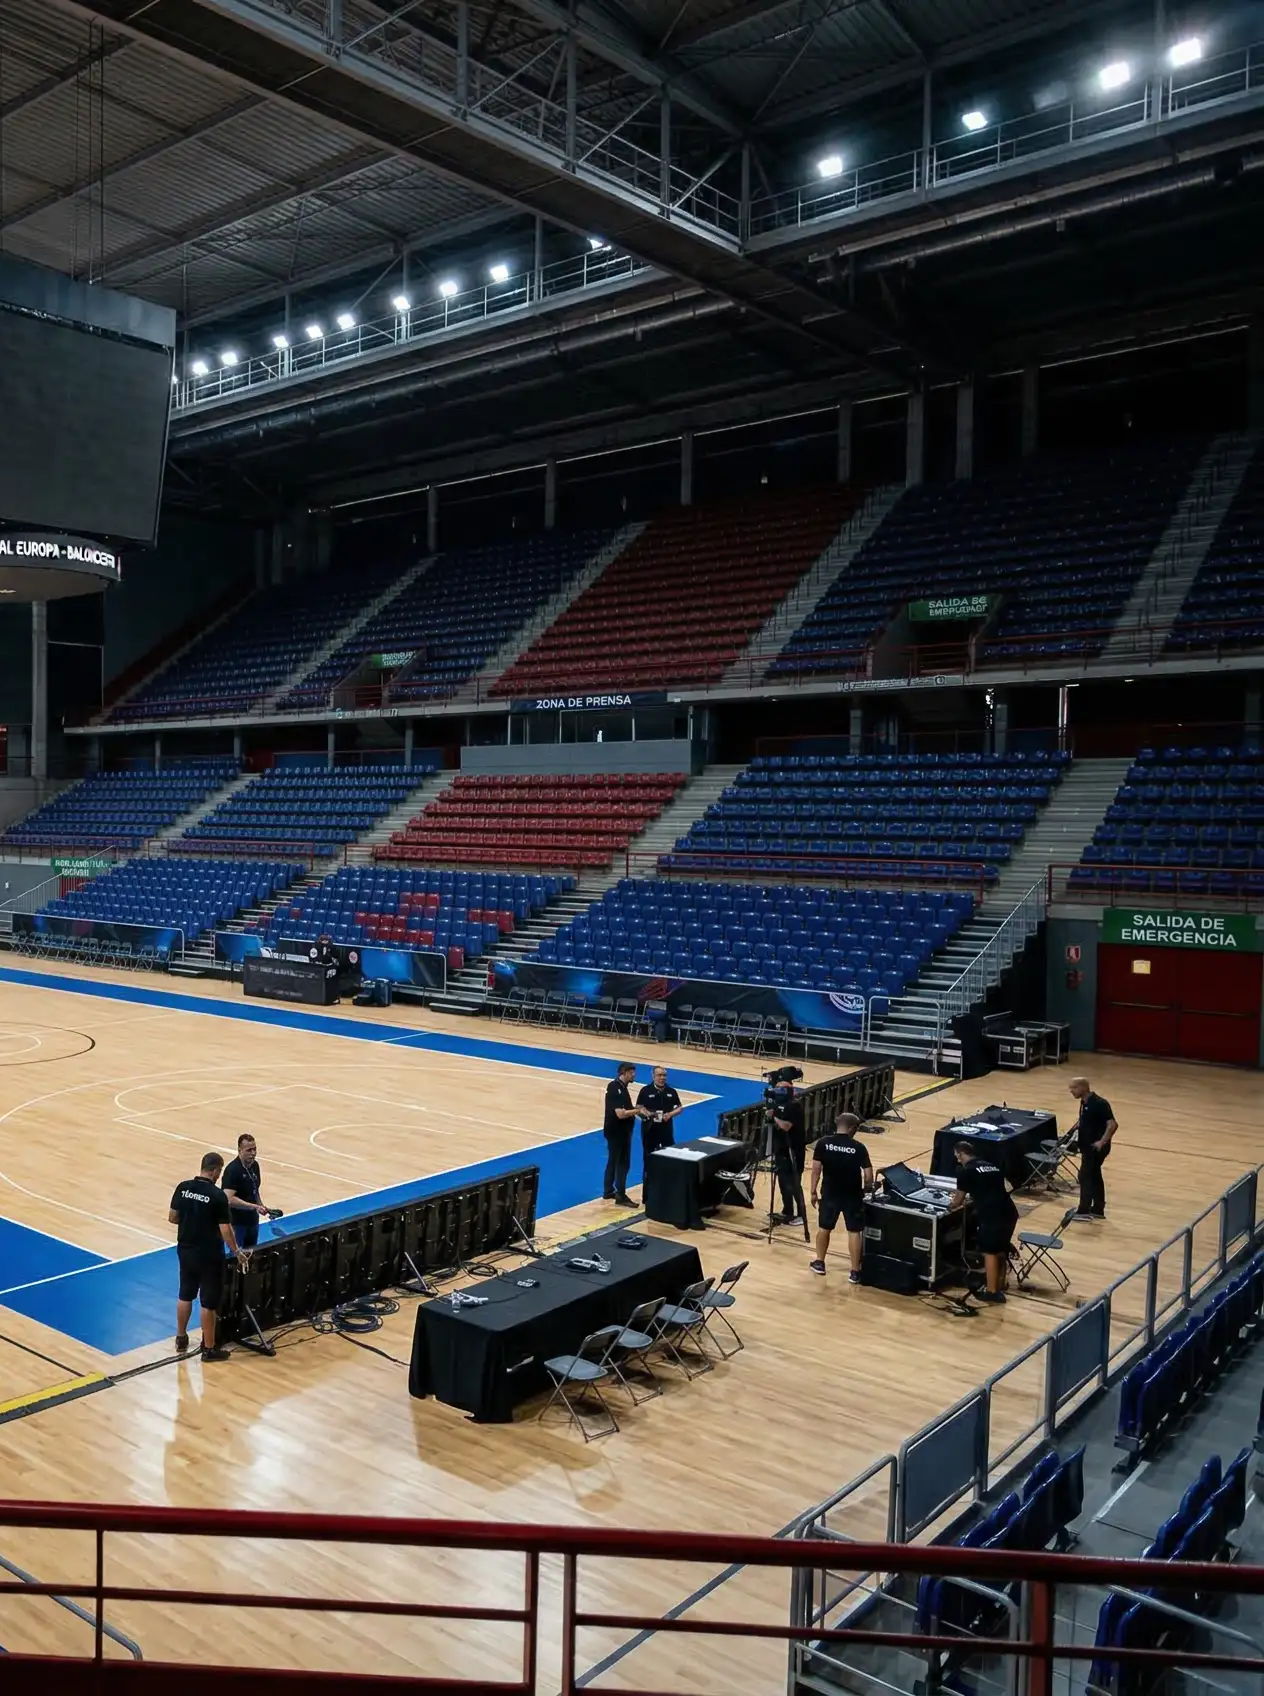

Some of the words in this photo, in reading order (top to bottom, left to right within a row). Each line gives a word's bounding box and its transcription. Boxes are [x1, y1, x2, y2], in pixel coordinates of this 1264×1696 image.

[16, 541, 60, 558] EUROPA
[928, 597, 969, 609] SALIDA
[568, 697, 583, 707] DE
[586, 694, 632, 706] PRENSA
[1132, 914, 1196, 929] SALIDA
[1201, 917, 1225, 930] DE
[1121, 928, 1237, 947] EMERGENCIA
